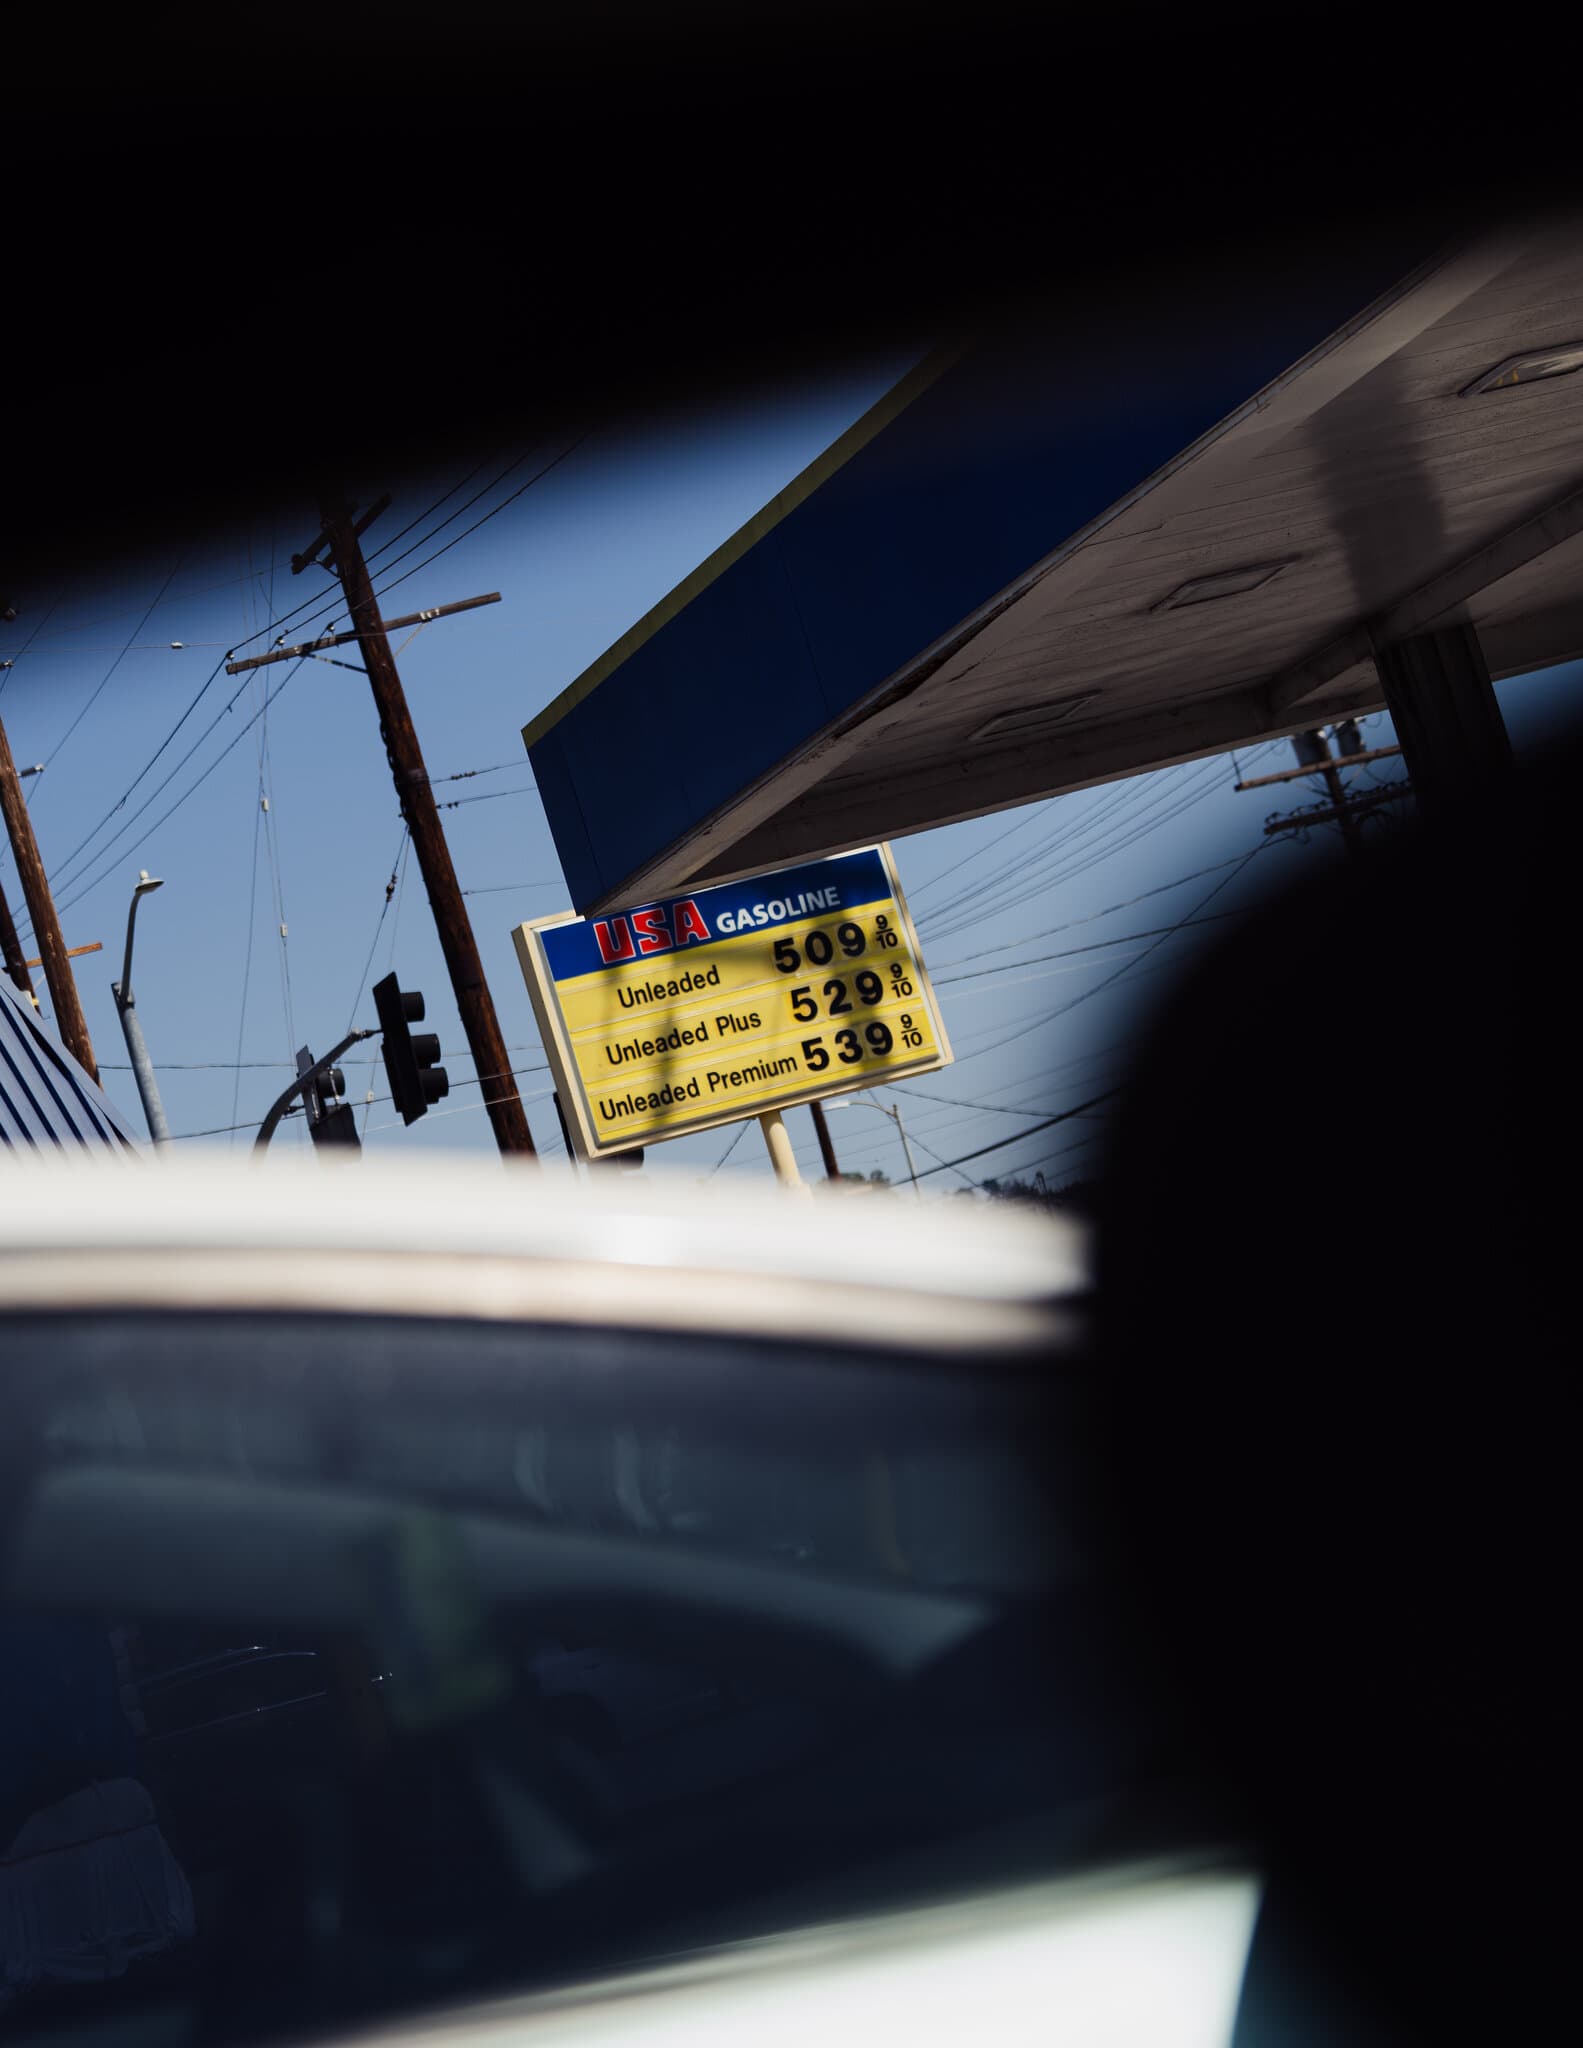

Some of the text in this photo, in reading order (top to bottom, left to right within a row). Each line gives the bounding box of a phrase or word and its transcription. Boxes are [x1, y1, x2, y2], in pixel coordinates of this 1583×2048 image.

[593, 887, 841, 964] USA GASOLINE
[618, 922, 866, 1008] Unleaded 509
[606, 971, 883, 1065] Unleaded Plus 529
[600, 1022, 893, 1120] Unleaded Premium 539
